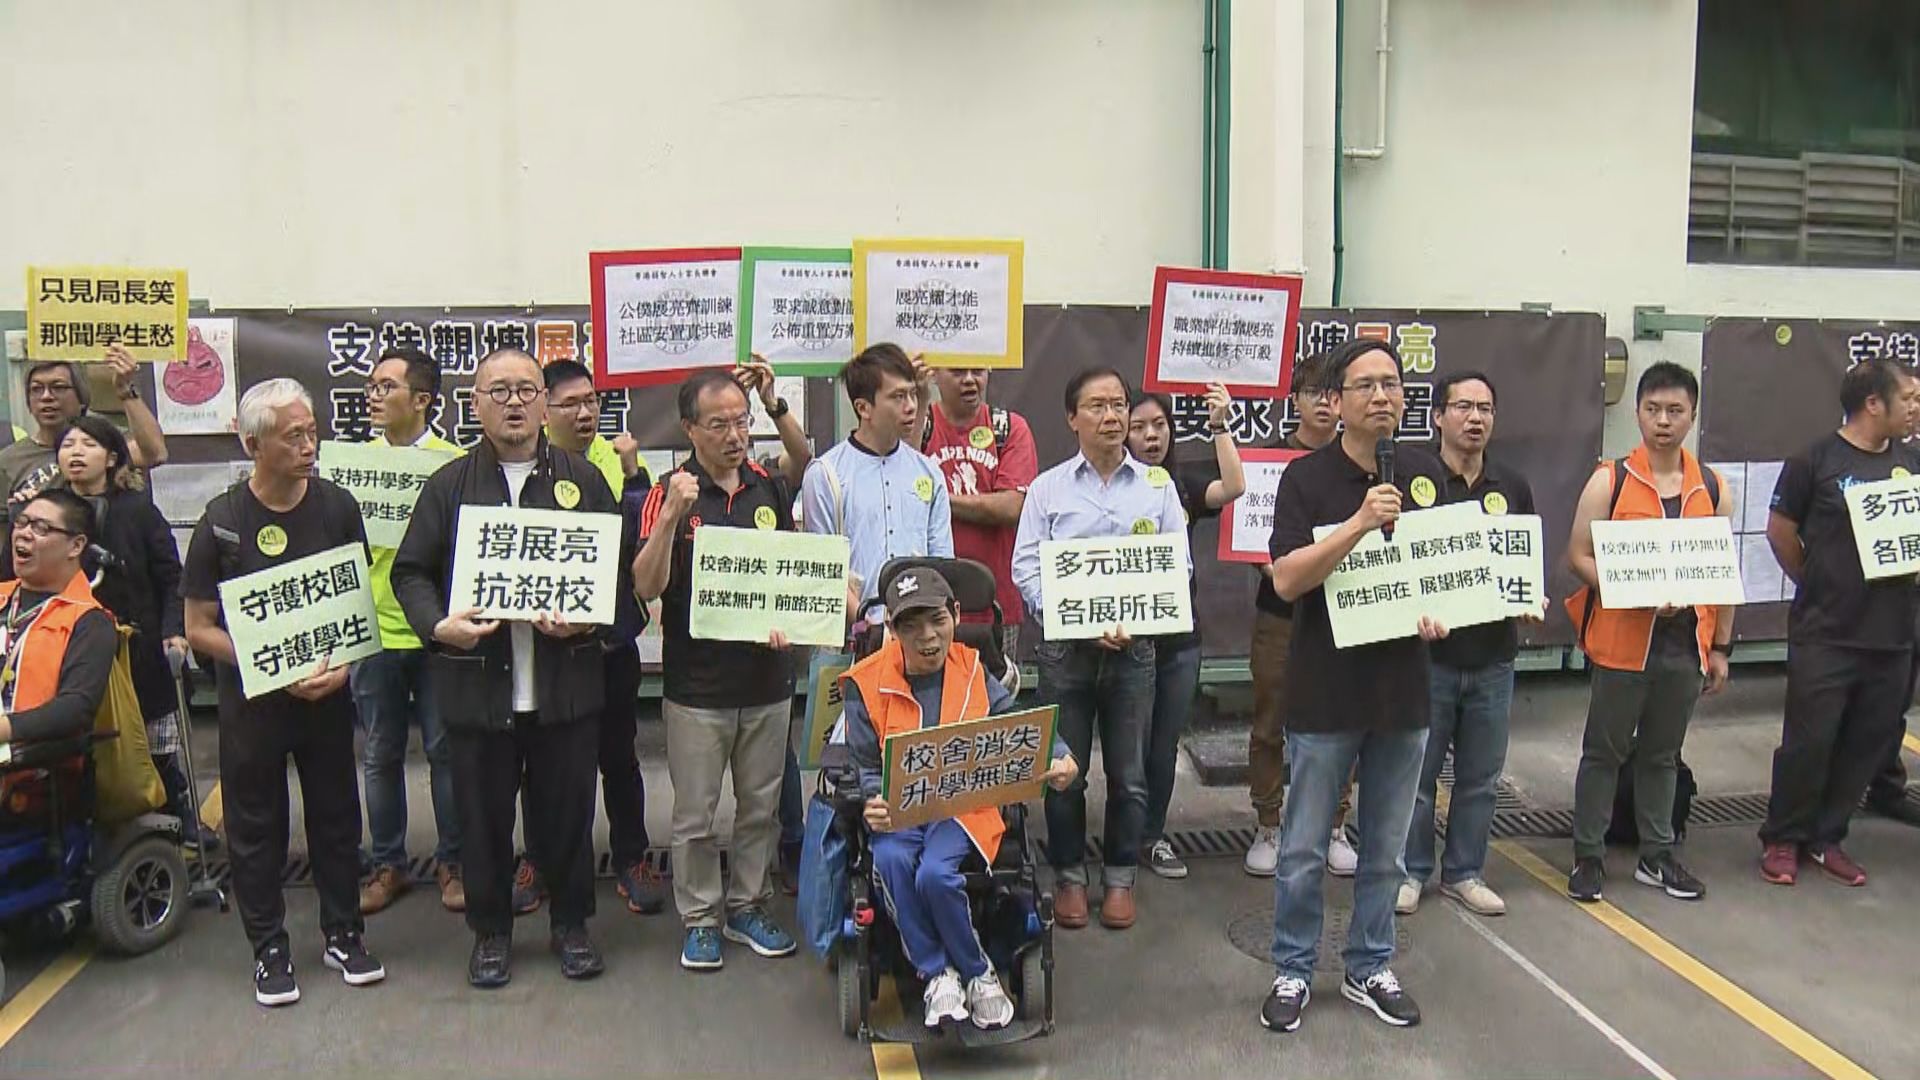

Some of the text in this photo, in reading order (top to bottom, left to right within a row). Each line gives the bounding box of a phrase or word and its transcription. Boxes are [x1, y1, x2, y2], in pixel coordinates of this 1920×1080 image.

[40, 279, 175, 304] 只見局長笑
[896, 288, 979, 307] 展亮耀才能
[40, 322, 175, 347] 那聞學生愁
[619, 321, 734, 346] 社區安置真共融
[896, 312, 979, 331] 殺校太殘忍
[328, 321, 592, 376] 支持觀塘展
[1171, 339, 1272, 361] 持續進修不可殺
[1861, 488, 1920, 521] 多元
[477, 521, 600, 563] 撐展亮
[1411, 531, 1483, 560] 展亮有愛
[699, 553, 843, 580] 校舍消失 升學無望
[1055, 546, 1176, 579] 多元選擇
[239, 559, 361, 622] 守護校園
[471, 571, 595, 614] 抗殺校
[697, 589, 842, 615] 就業無門 前路茫茫
[1336, 566, 1492, 610] 師生同在 展望將來
[1496, 576, 1534, 604] 生
[1057, 592, 1180, 626] 各展所長
[252, 615, 372, 677] 守護學生
[903, 723, 1041, 774] 校舍消失
[899, 755, 1036, 812] 升學無望
